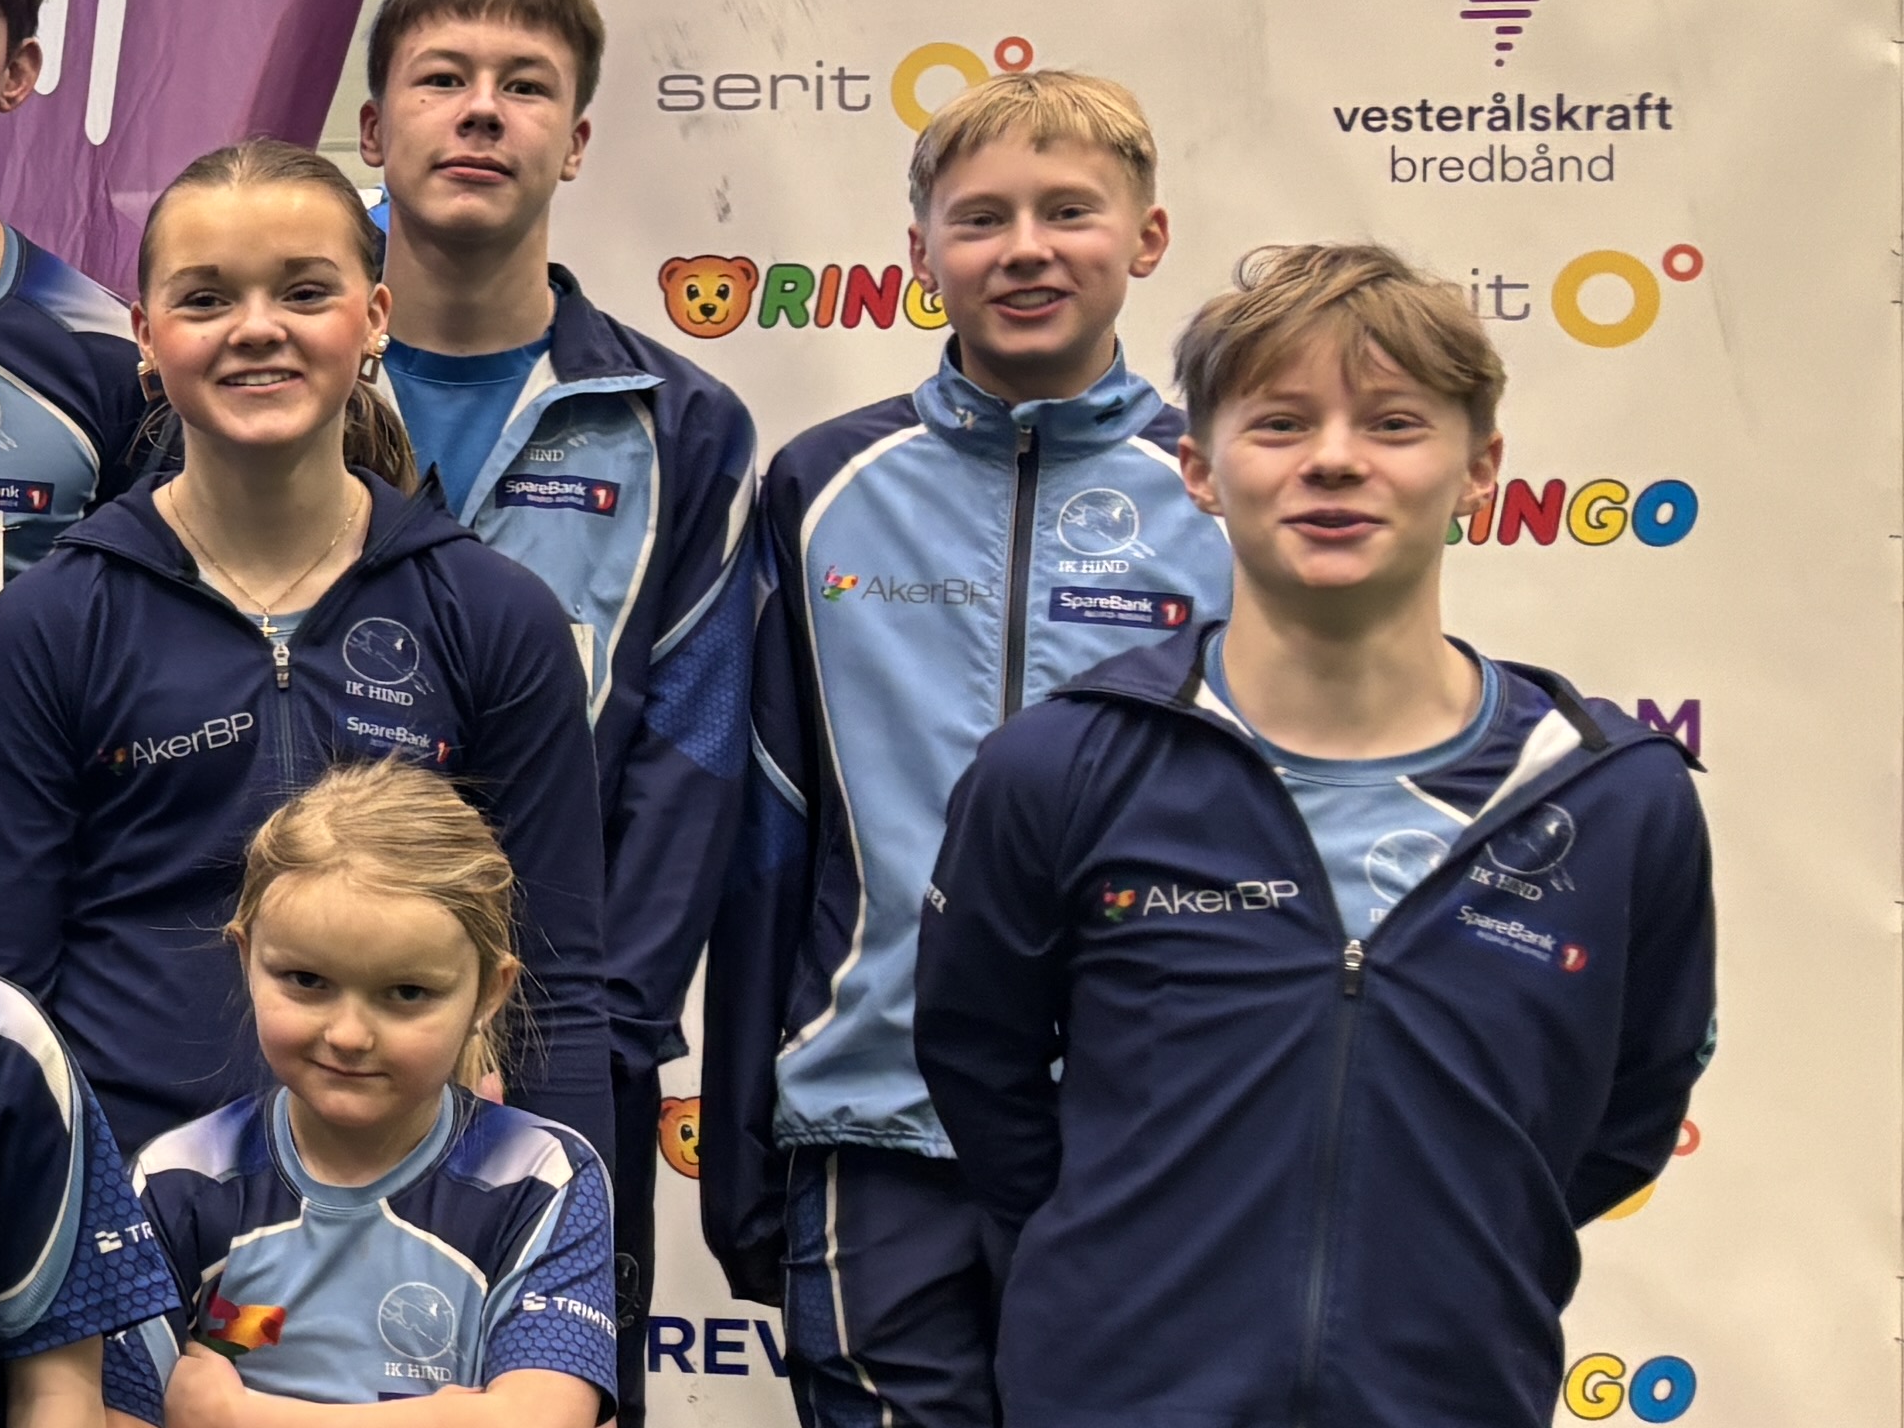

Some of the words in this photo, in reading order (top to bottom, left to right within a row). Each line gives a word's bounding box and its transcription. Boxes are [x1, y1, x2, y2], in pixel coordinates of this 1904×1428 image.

[656, 63, 872, 113] serit
[1334, 92, 1672, 136] vesterålskraft
[1390, 143, 1615, 185] bredbånd
[758, 263, 950, 329] RING
[505, 480, 587, 496] SpareBank
[1444, 478, 1698, 547] INGO
[1059, 560, 1076, 572] IK
[1082, 560, 1129, 574] HIND
[862, 576, 991, 606] AkerBP
[1060, 592, 1153, 615] SpareBank
[346, 680, 364, 696] IK
[368, 685, 414, 706] HIND
[131, 711, 254, 771] AkerBP
[347, 716, 431, 748] SpareBank
[1142, 879, 1299, 916] AkerBP
[1471, 866, 1493, 885] IK
[1496, 873, 1543, 902] HIND
[1456, 905, 1557, 952] SpareBank
[552, 1297, 616, 1340] TRIMTE
[384, 1362, 403, 1378] IK
[407, 1364, 452, 1383] HIND
